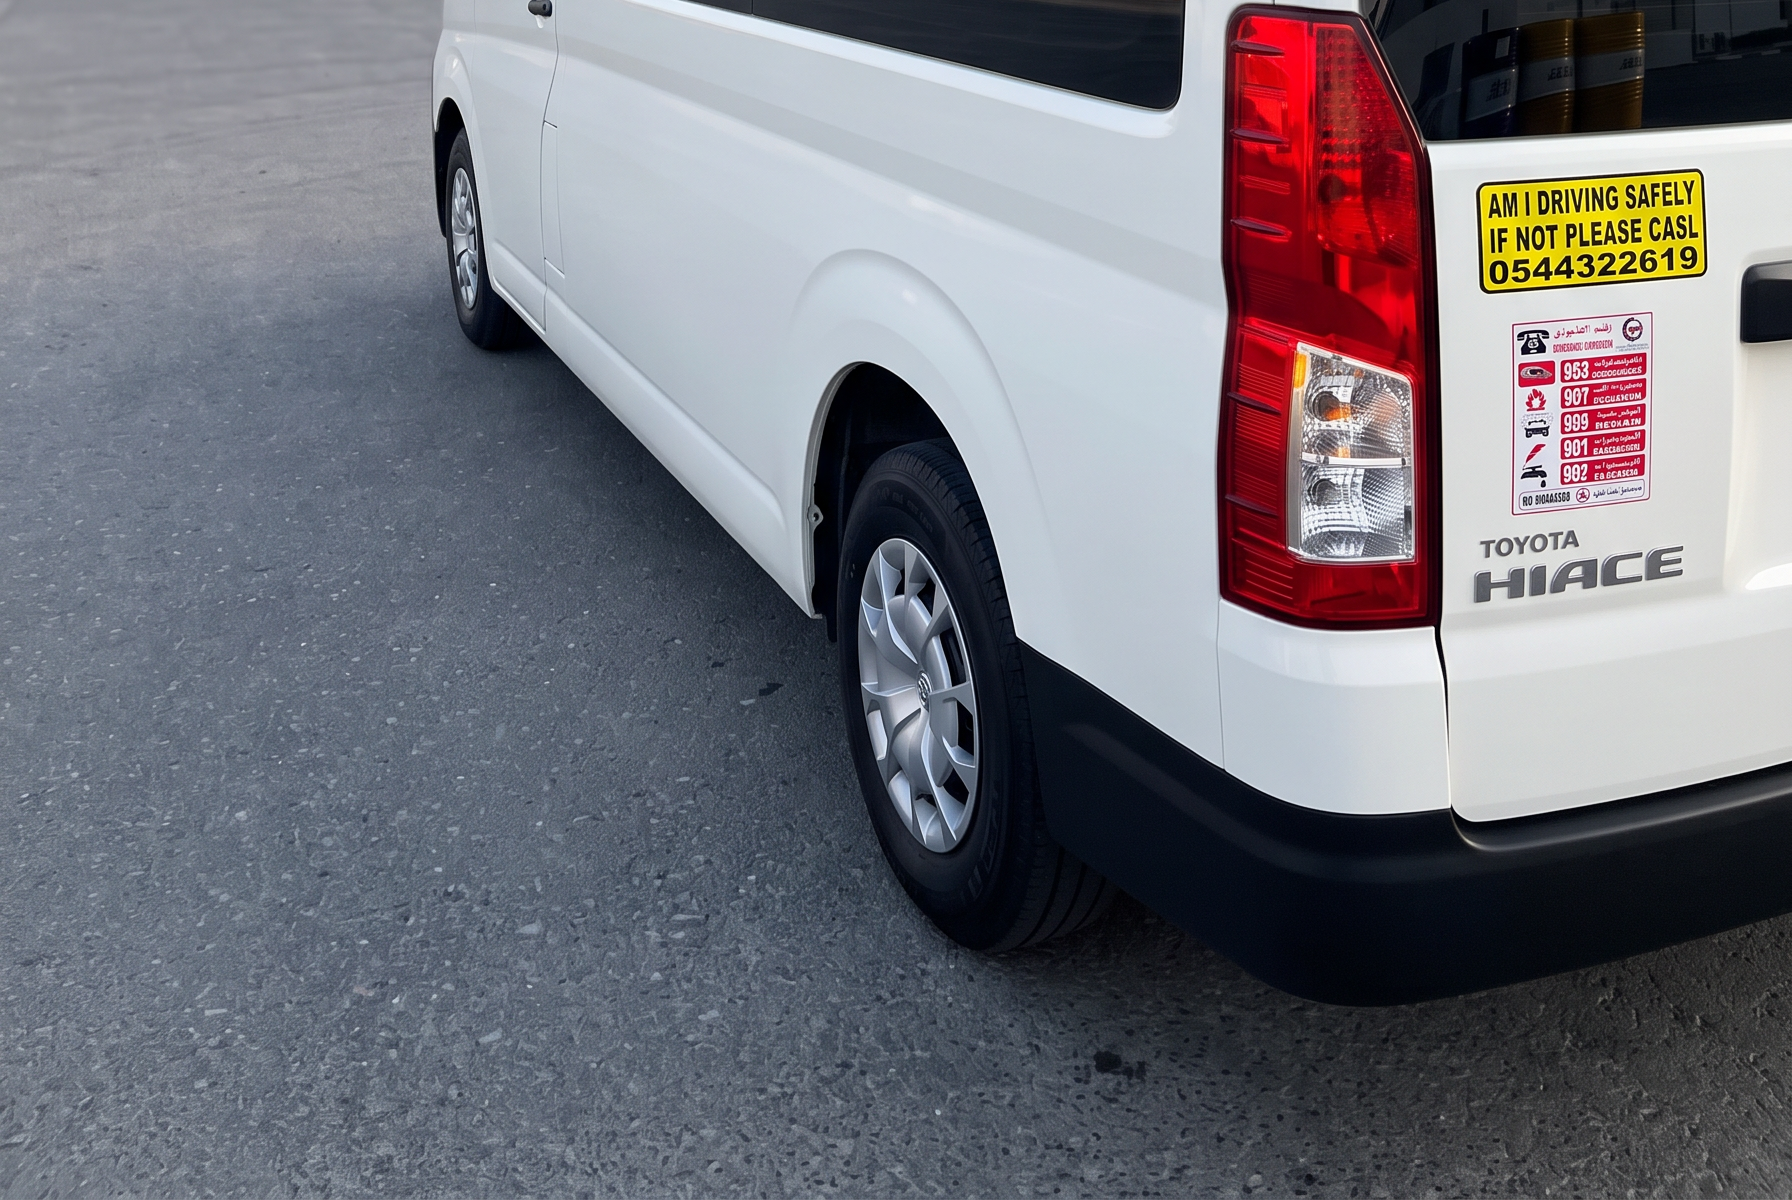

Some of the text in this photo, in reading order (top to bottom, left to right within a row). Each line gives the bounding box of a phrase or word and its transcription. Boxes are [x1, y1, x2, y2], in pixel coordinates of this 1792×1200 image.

[1488, 180, 1695, 219] AM I DRIVING SAFELY
[1490, 214, 1699, 254] IF NOT PLEASE CASL
[1489, 246, 1698, 285] 0544322619
[1480, 529, 1580, 559] TOYOTA
[1473, 545, 1684, 603] HIACE
